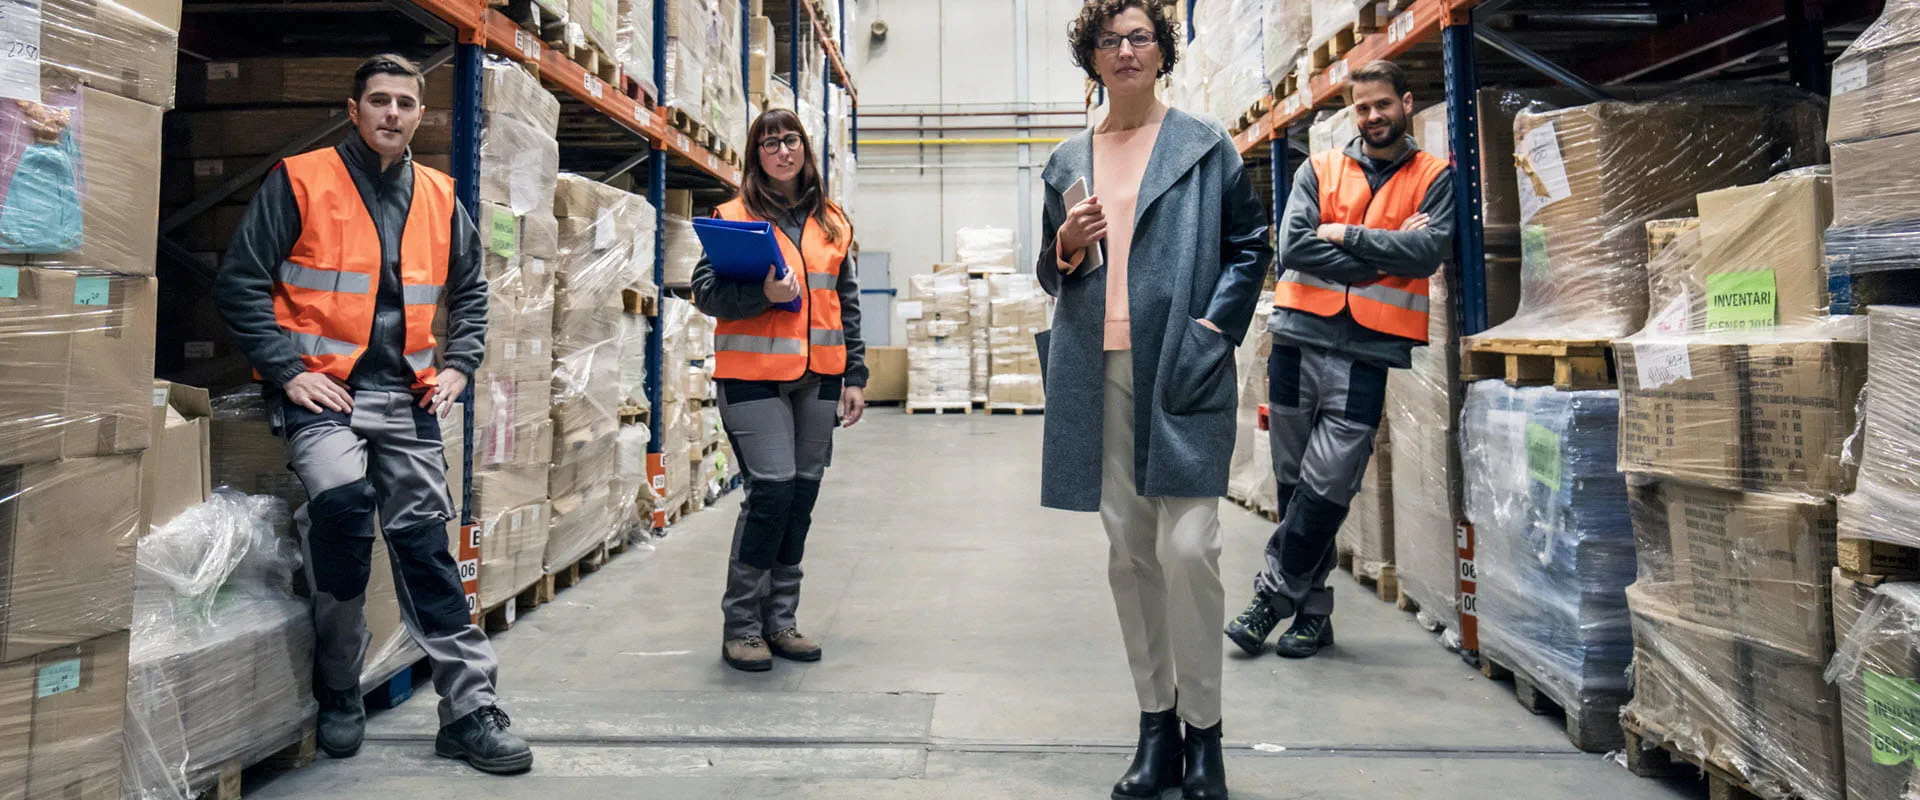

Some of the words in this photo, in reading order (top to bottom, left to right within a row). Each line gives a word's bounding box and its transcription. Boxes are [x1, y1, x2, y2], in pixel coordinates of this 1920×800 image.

[1714, 291, 1771, 307] INVENTARI
[461, 563, 475, 578] 06
[1462, 562, 1476, 579] 06
[468, 596, 475, 611] 0
